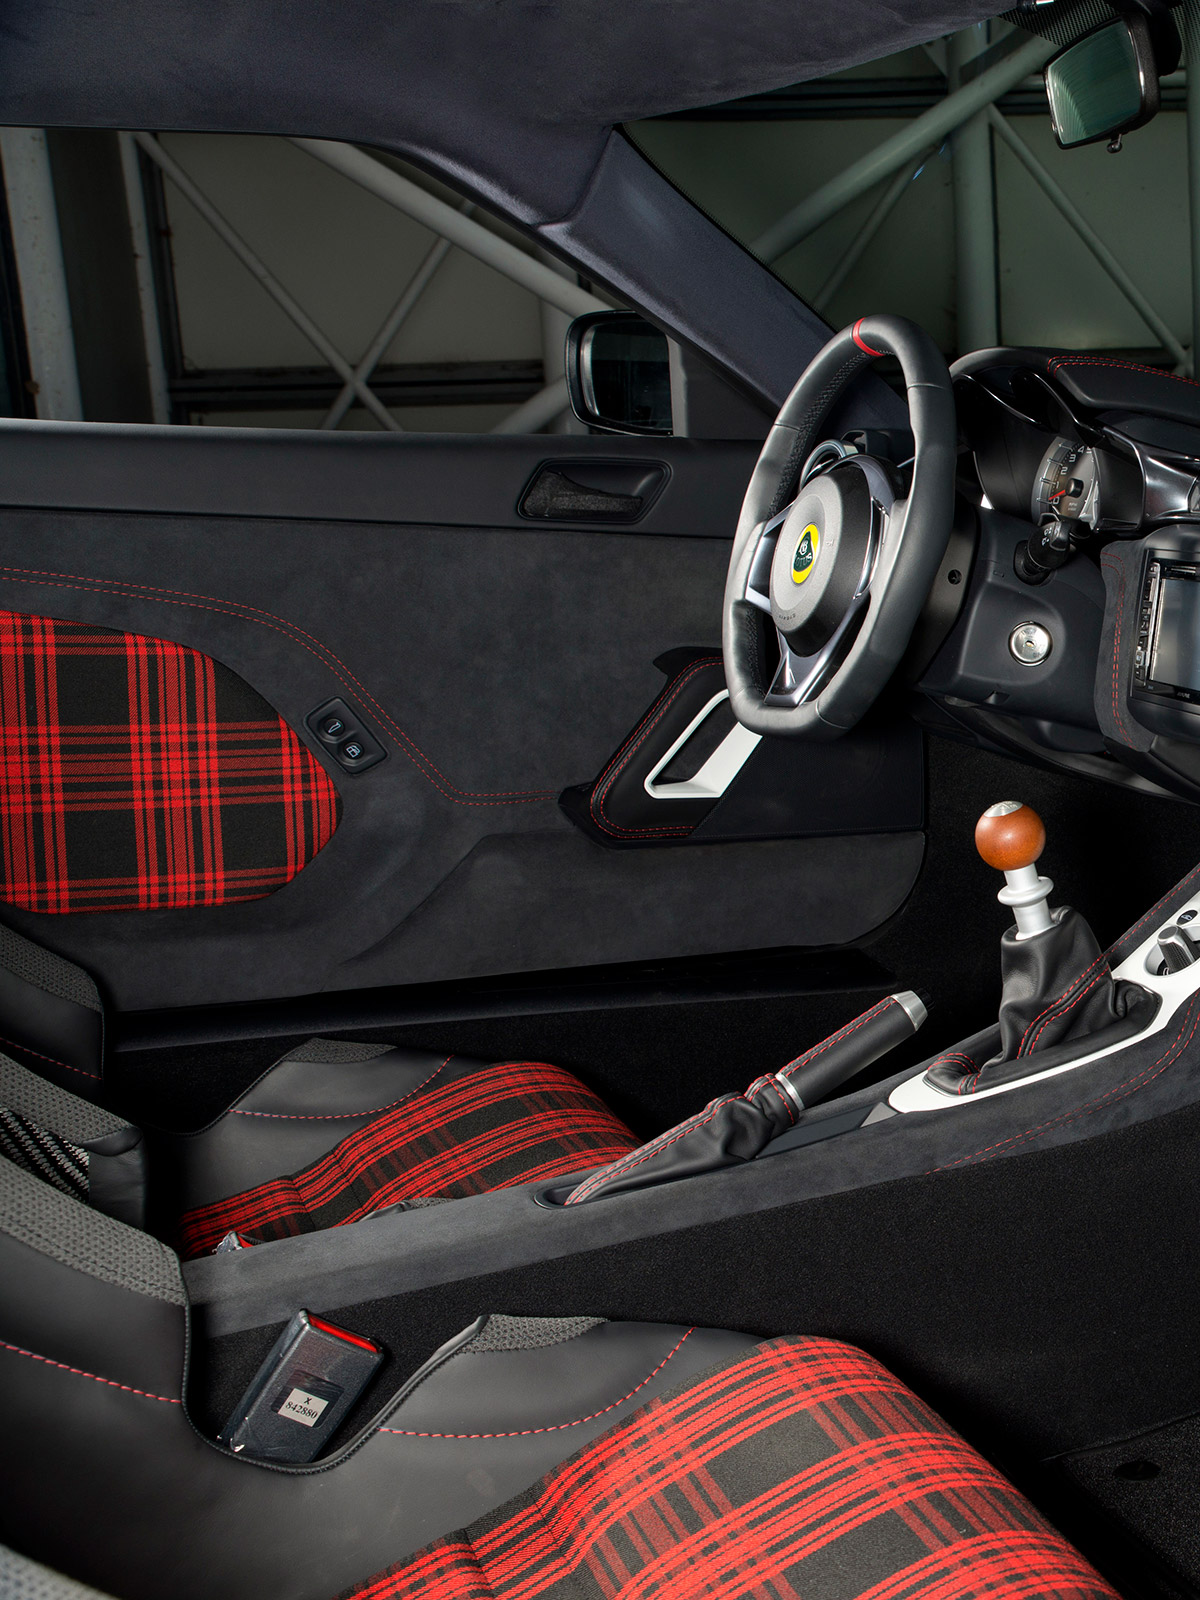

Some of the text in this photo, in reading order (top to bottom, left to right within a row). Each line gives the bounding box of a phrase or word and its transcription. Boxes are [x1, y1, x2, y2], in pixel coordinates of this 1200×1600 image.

[1078, 446, 1084, 454] 4
[1069, 454, 1076, 462] 3
[1060, 466, 1068, 474] 2
[1052, 496, 1060, 504] 0
[794, 552, 812, 565] OTUS
[304, 1397, 312, 1405] X
[286, 1401, 318, 1418] 842880
